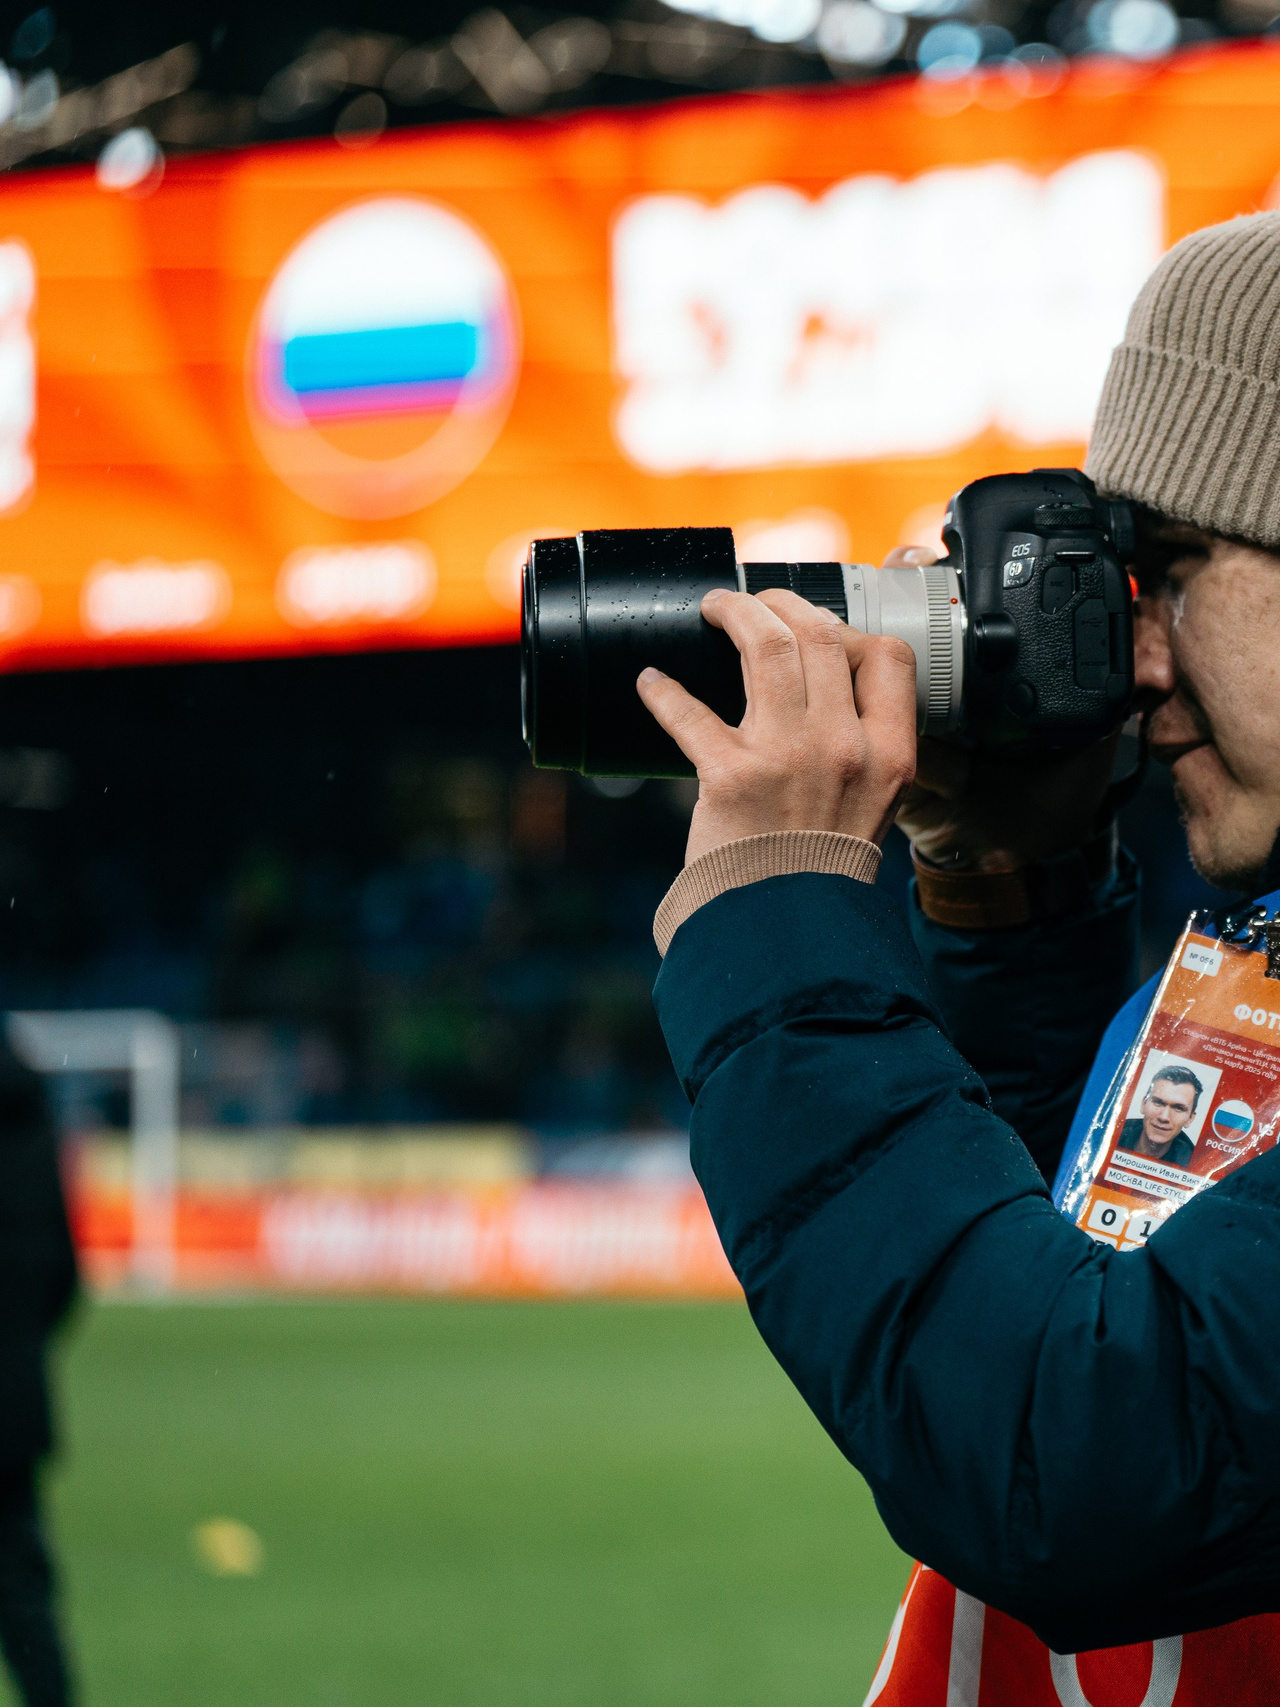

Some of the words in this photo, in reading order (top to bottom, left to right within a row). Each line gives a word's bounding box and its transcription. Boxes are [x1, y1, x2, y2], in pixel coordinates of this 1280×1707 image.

[1012, 543, 1031, 557] EOS
[1009, 562, 1022, 577] 6D
[853, 583, 861, 591] 70
[1214, 1055, 1223, 1064] 25
[1244, 1065, 1261, 1075] 2025
[1205, 1139, 1242, 1155] РОССИЯ
[1114, 1153, 1158, 1173] Мирошкин
[1158, 1168, 1180, 1180] Иван
[1108, 1170, 1143, 1187] МОСКВА
[1144, 1181, 1163, 1193] LIFE
